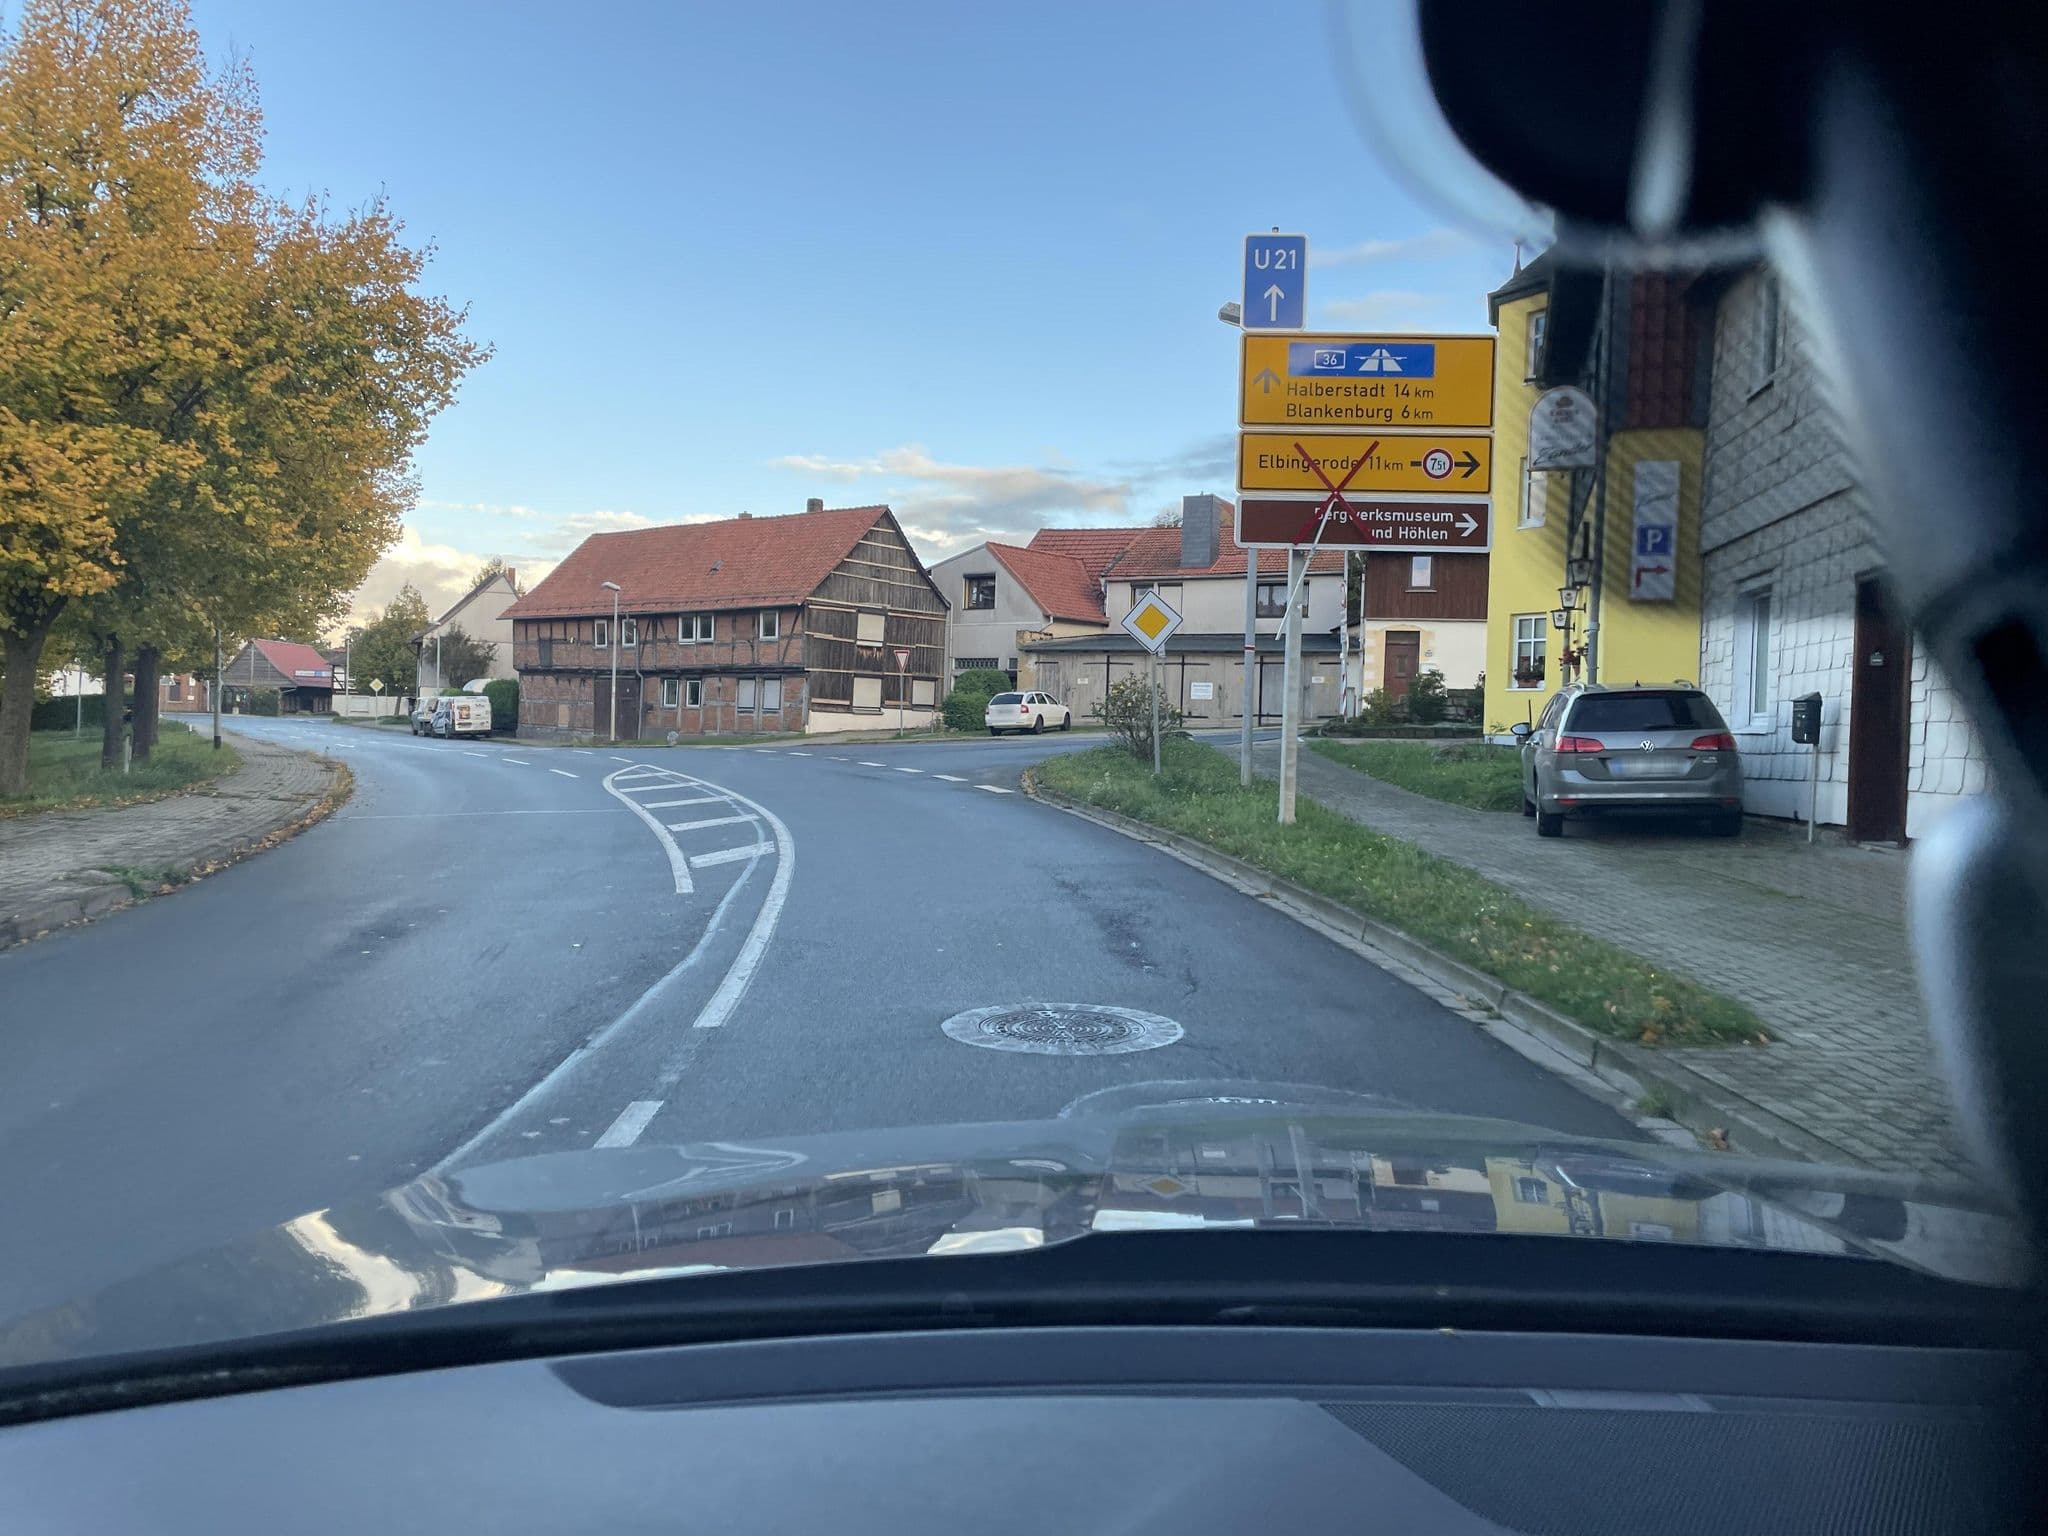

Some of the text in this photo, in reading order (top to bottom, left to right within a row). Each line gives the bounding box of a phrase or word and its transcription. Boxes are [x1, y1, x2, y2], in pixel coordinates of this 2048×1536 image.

[1323, 353, 1337, 365] 36
[1286, 383, 1434, 398] Halberstadt 14 km
[1286, 404, 1433, 422] Blankenburg 6 km
[1369, 456, 1380, 470] 11
[1384, 461, 1403, 470] km
[1399, 526, 1448, 540] Höhlen
